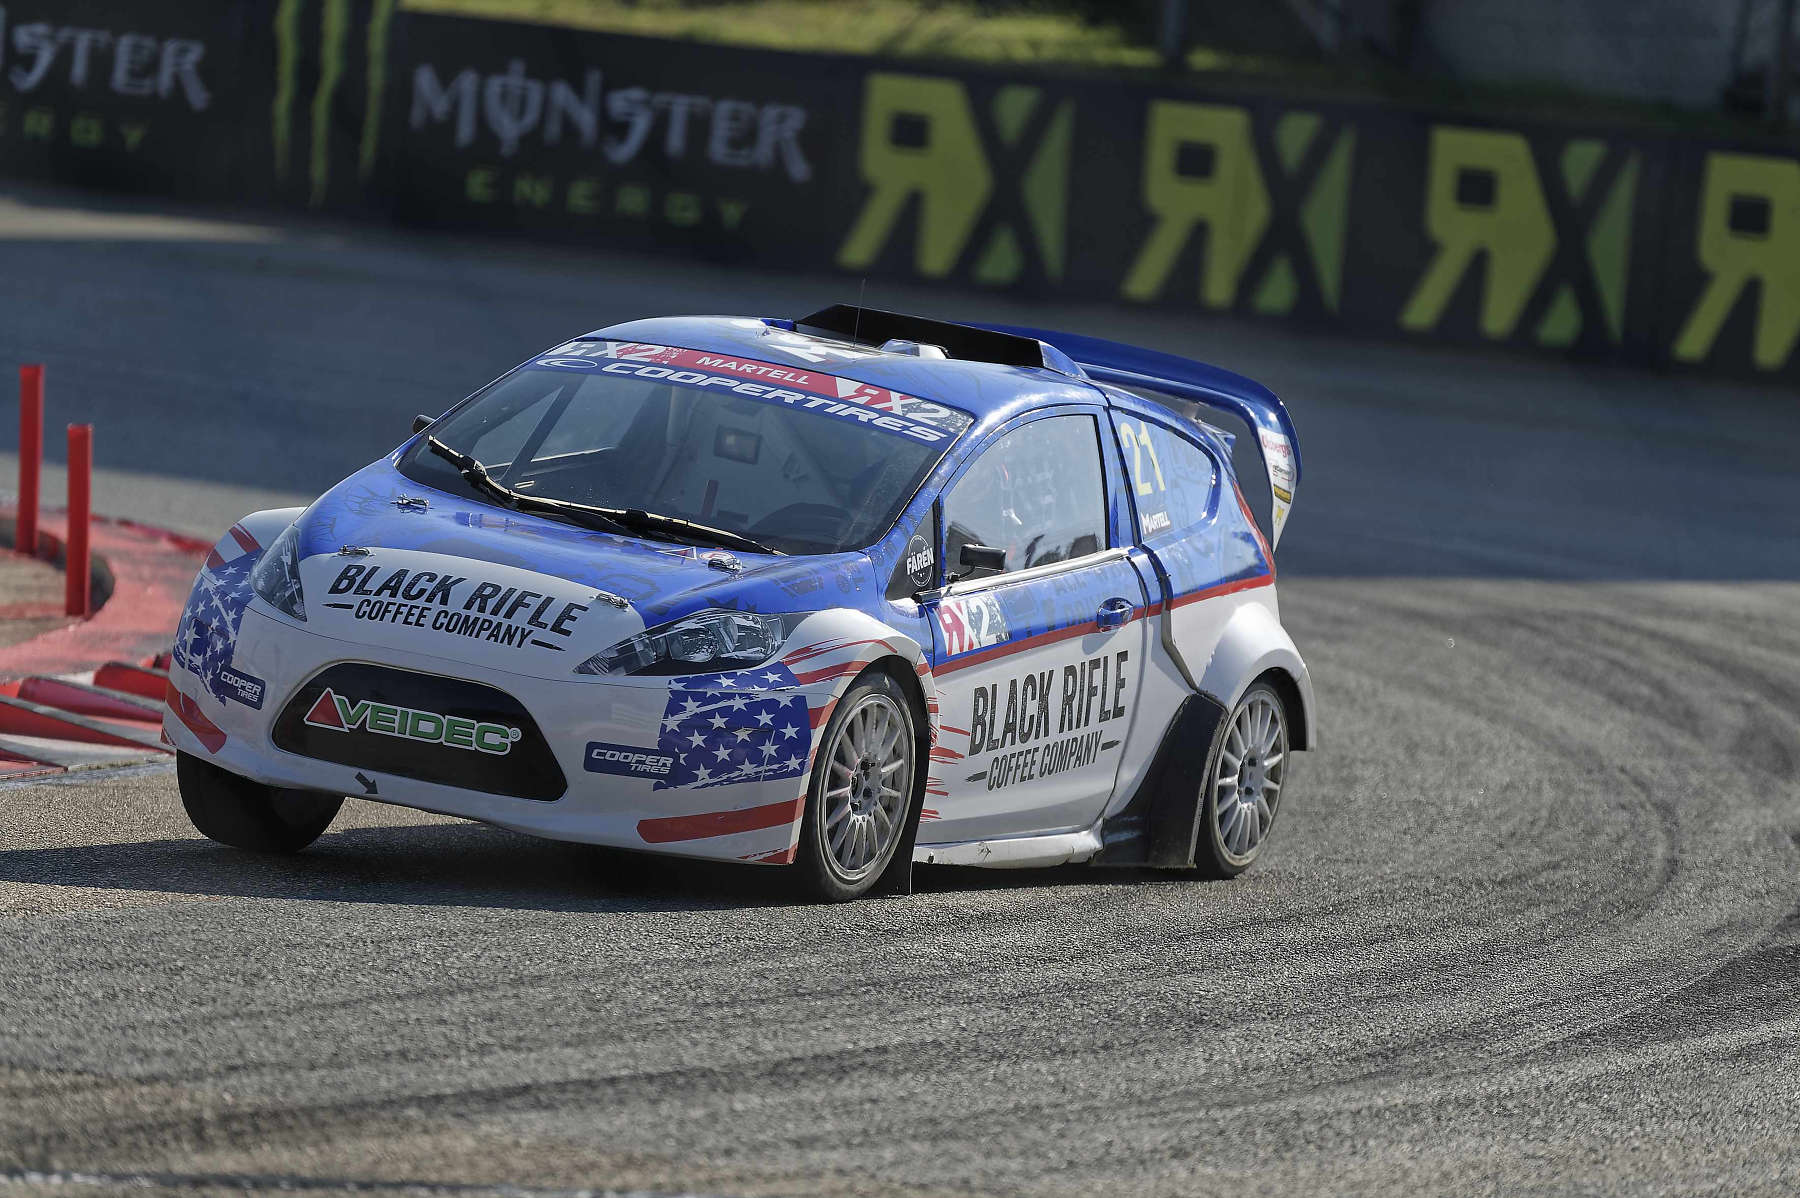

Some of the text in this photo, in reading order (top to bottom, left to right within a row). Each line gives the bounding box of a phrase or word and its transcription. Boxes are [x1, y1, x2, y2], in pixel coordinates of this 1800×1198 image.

[0, 3, 210, 112] STER
[408, 57, 811, 183] MONSTER
[463, 167, 748, 232] ENERGY
[696, 356, 809, 385] MARTELL
[1120, 421, 1166, 496] 21
[328, 564, 589, 637] BLACK RIFLE
[354, 598, 534, 648] COFFEE COMPANY
[220, 671, 262, 696] COOPER
[237, 688, 259, 702] TIRES
[969, 650, 1128, 756] BLACK RIFLE
[591, 748, 674, 767] COOPER
[630, 763, 671, 774] TIRES
[987, 730, 1103, 791] COFFEE COMPANY
